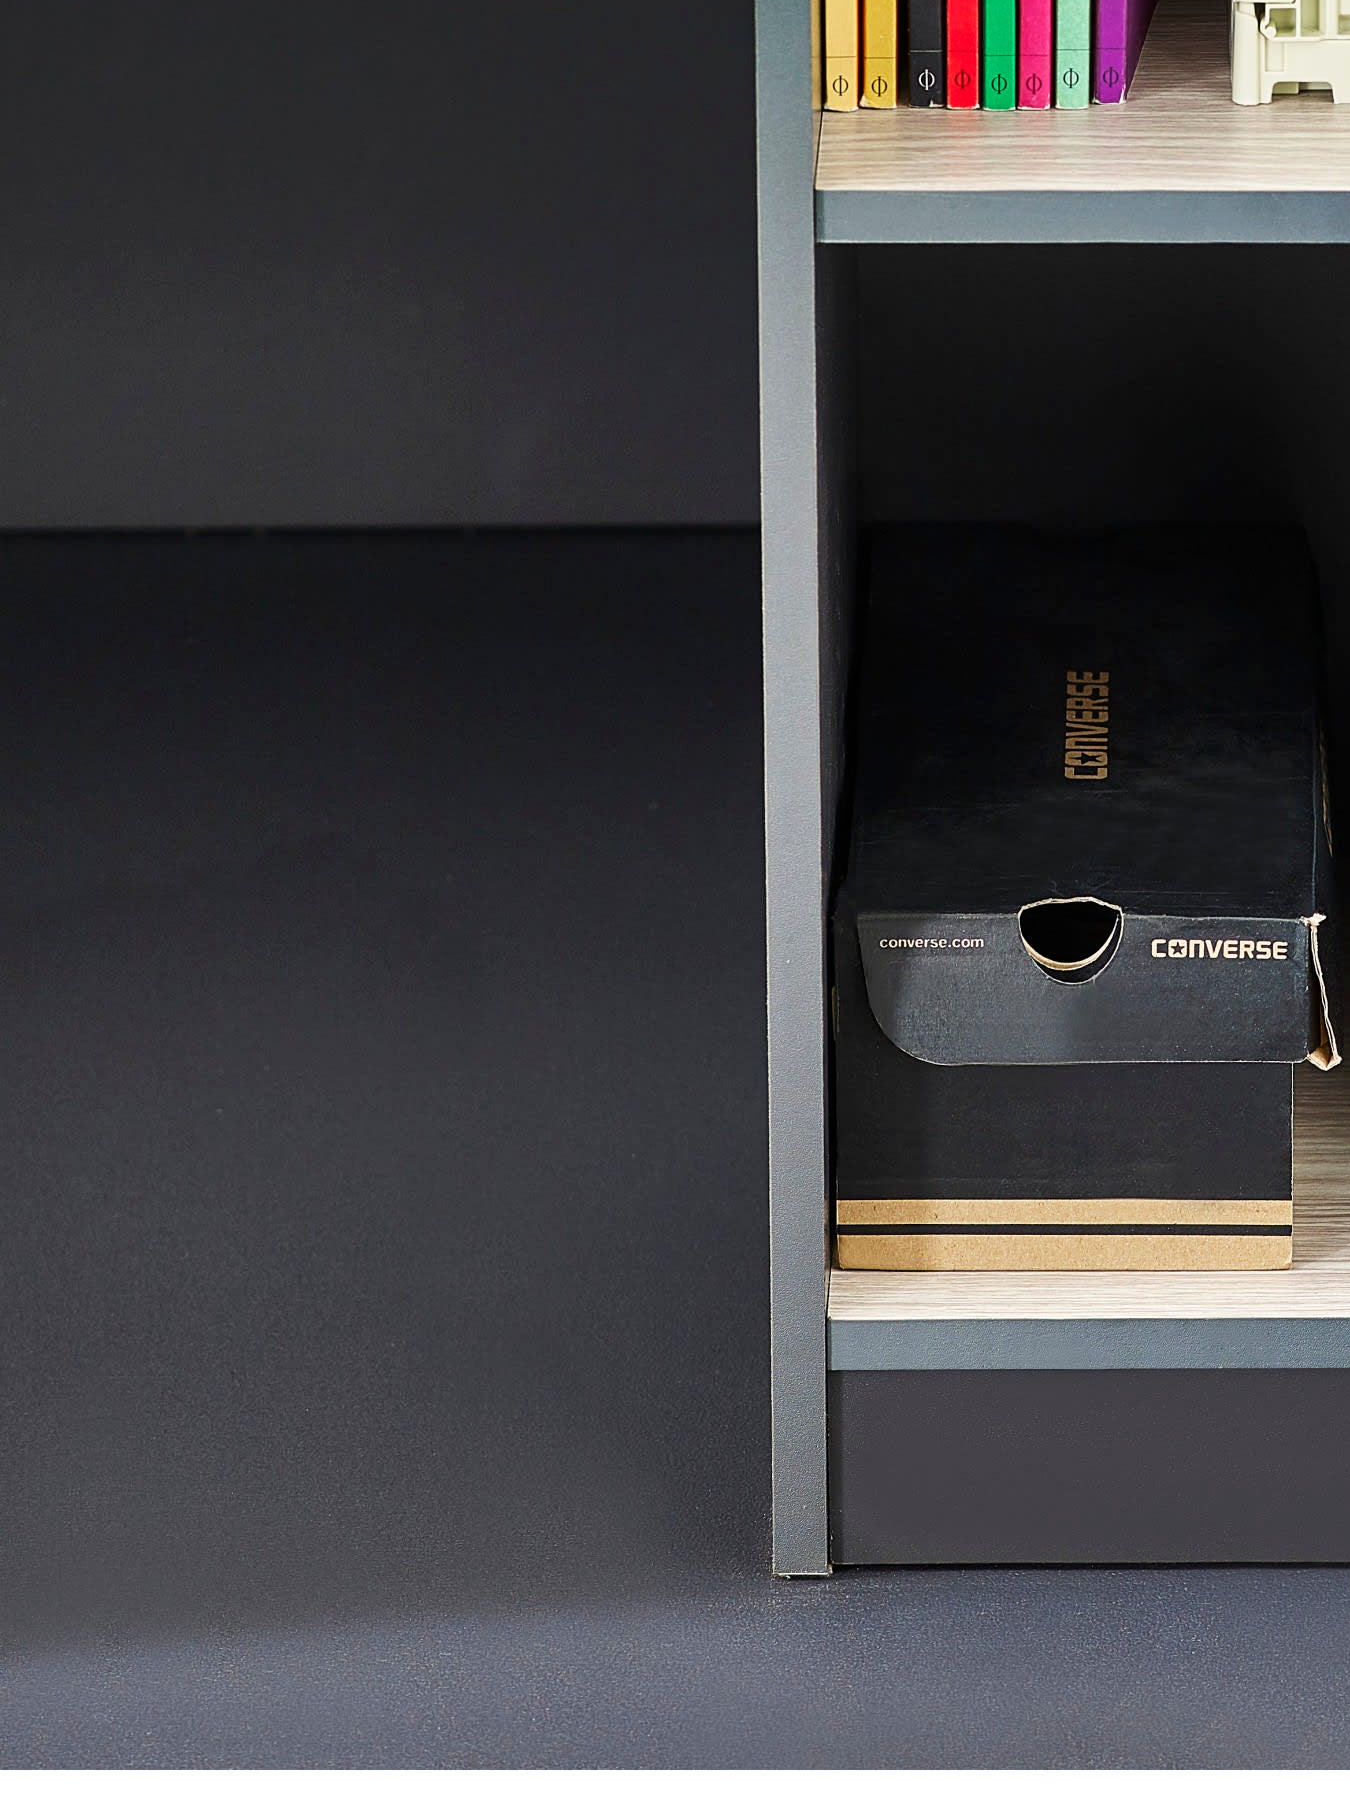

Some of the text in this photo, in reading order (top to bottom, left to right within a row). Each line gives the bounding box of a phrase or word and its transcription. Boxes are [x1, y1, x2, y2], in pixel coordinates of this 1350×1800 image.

[1064, 670, 1110, 780] CONVERSE
[879, 935, 985, 950] converse.com
[1150, 938, 1288, 960] CONVERSE
